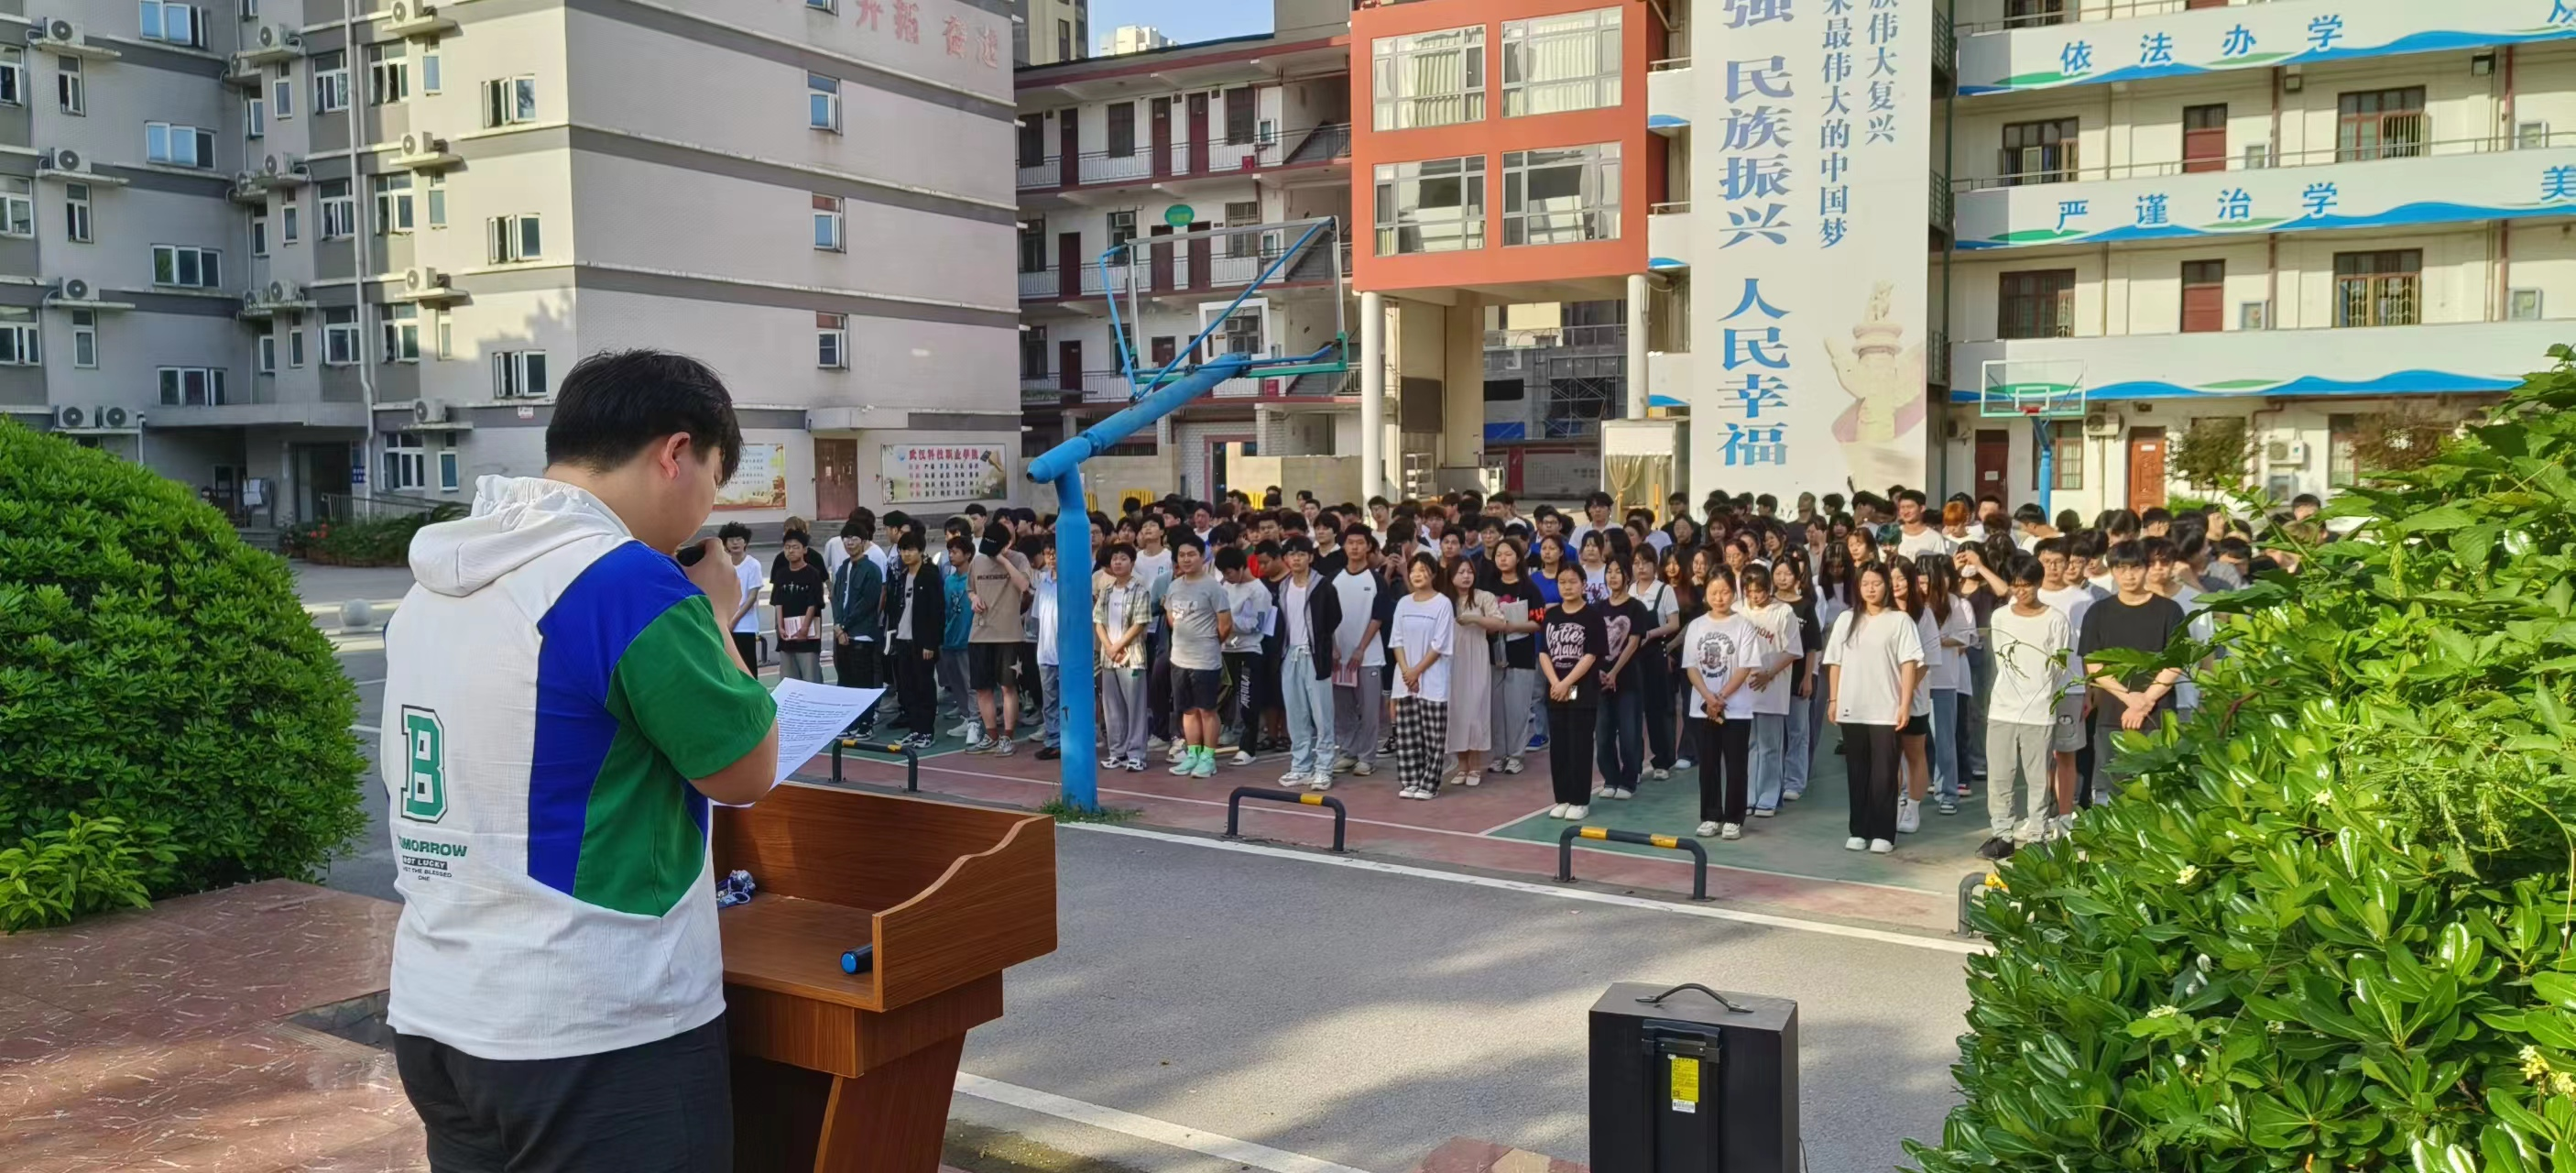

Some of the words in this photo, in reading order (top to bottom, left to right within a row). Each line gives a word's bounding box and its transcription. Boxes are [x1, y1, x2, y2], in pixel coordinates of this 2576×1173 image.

[1865, 0, 1899, 145] 伟大复兴
[2060, 15, 2342, 72] 依法办学
[1718, 55, 1795, 249] 民族振兴
[2058, 182, 2338, 230] 严谨治学
[1717, 278, 1792, 466] 人民幸福
[400, 704, 448, 824] B
[418, 859, 445, 869] LUCKY
[424, 869, 452, 878] BLESSED
